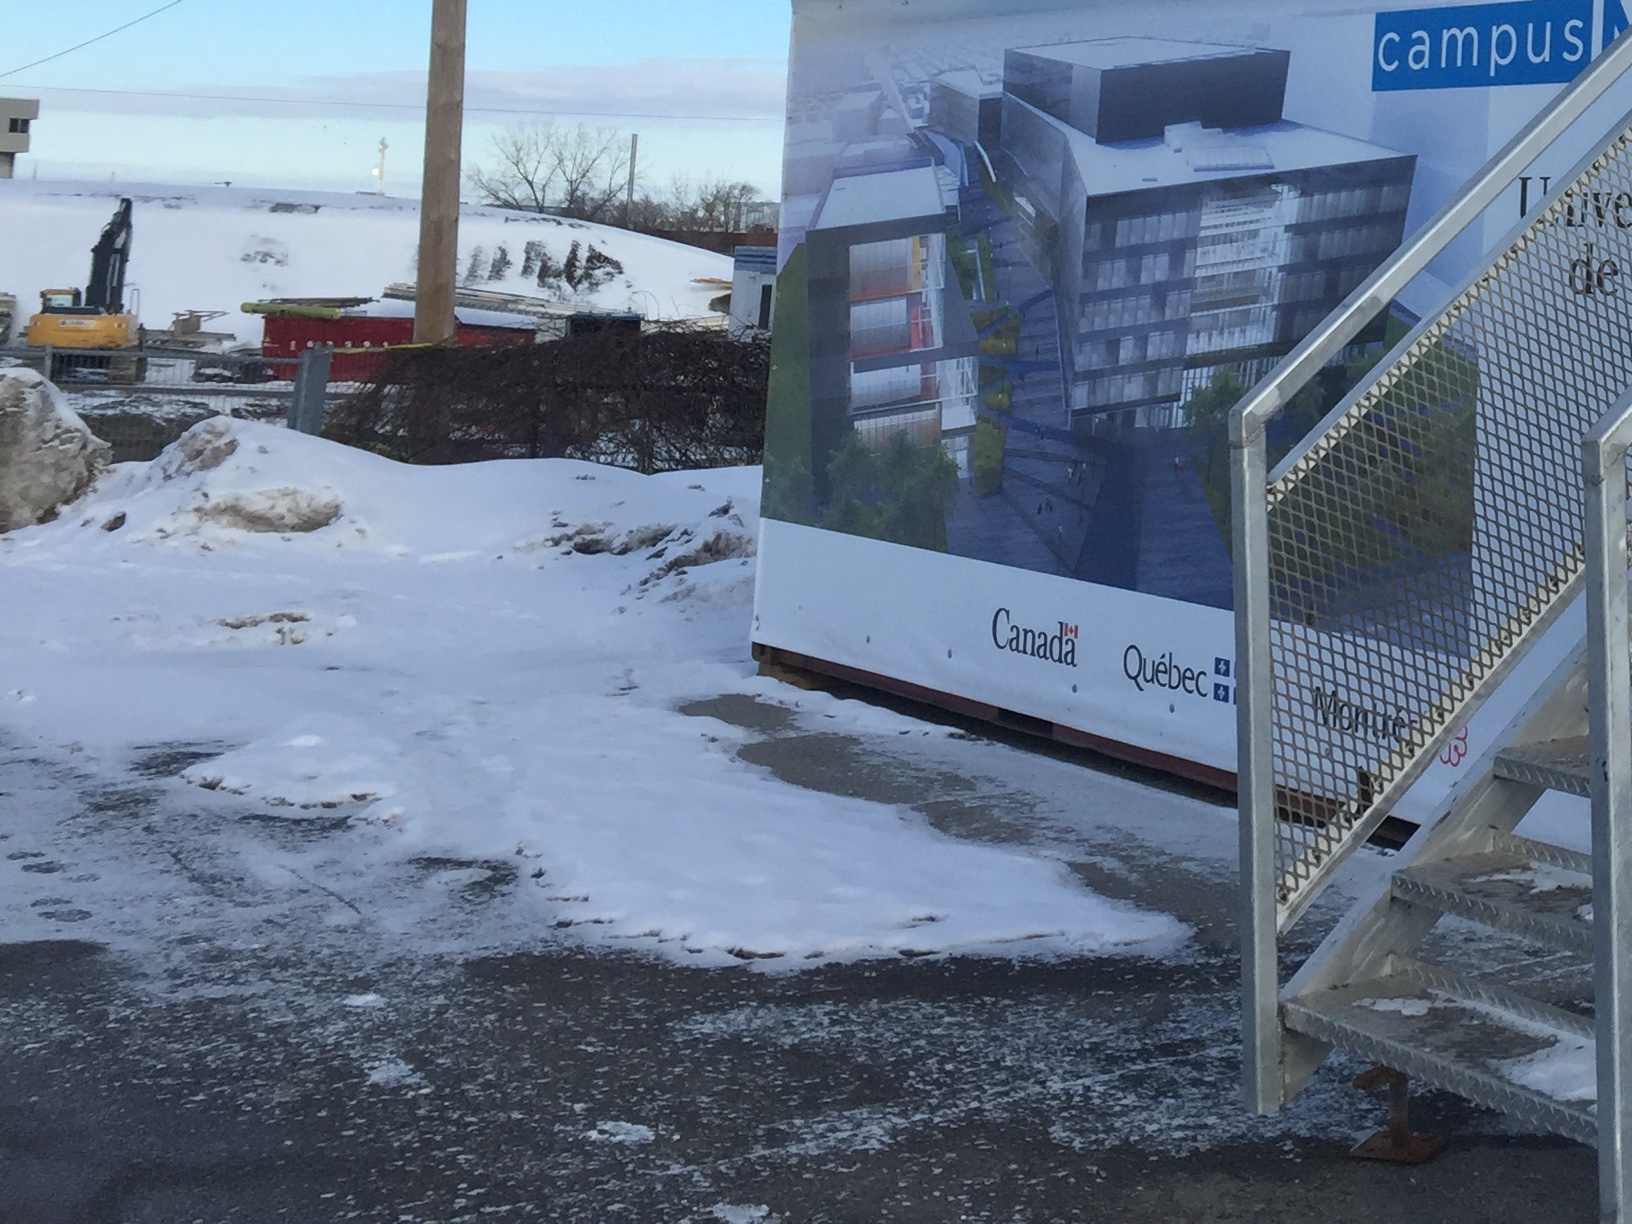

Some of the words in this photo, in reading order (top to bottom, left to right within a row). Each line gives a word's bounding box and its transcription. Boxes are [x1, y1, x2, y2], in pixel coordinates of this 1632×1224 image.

[1568, 243, 1618, 296] de
[992, 608, 1077, 667] Canada
[1123, 644, 1208, 697] Québec
